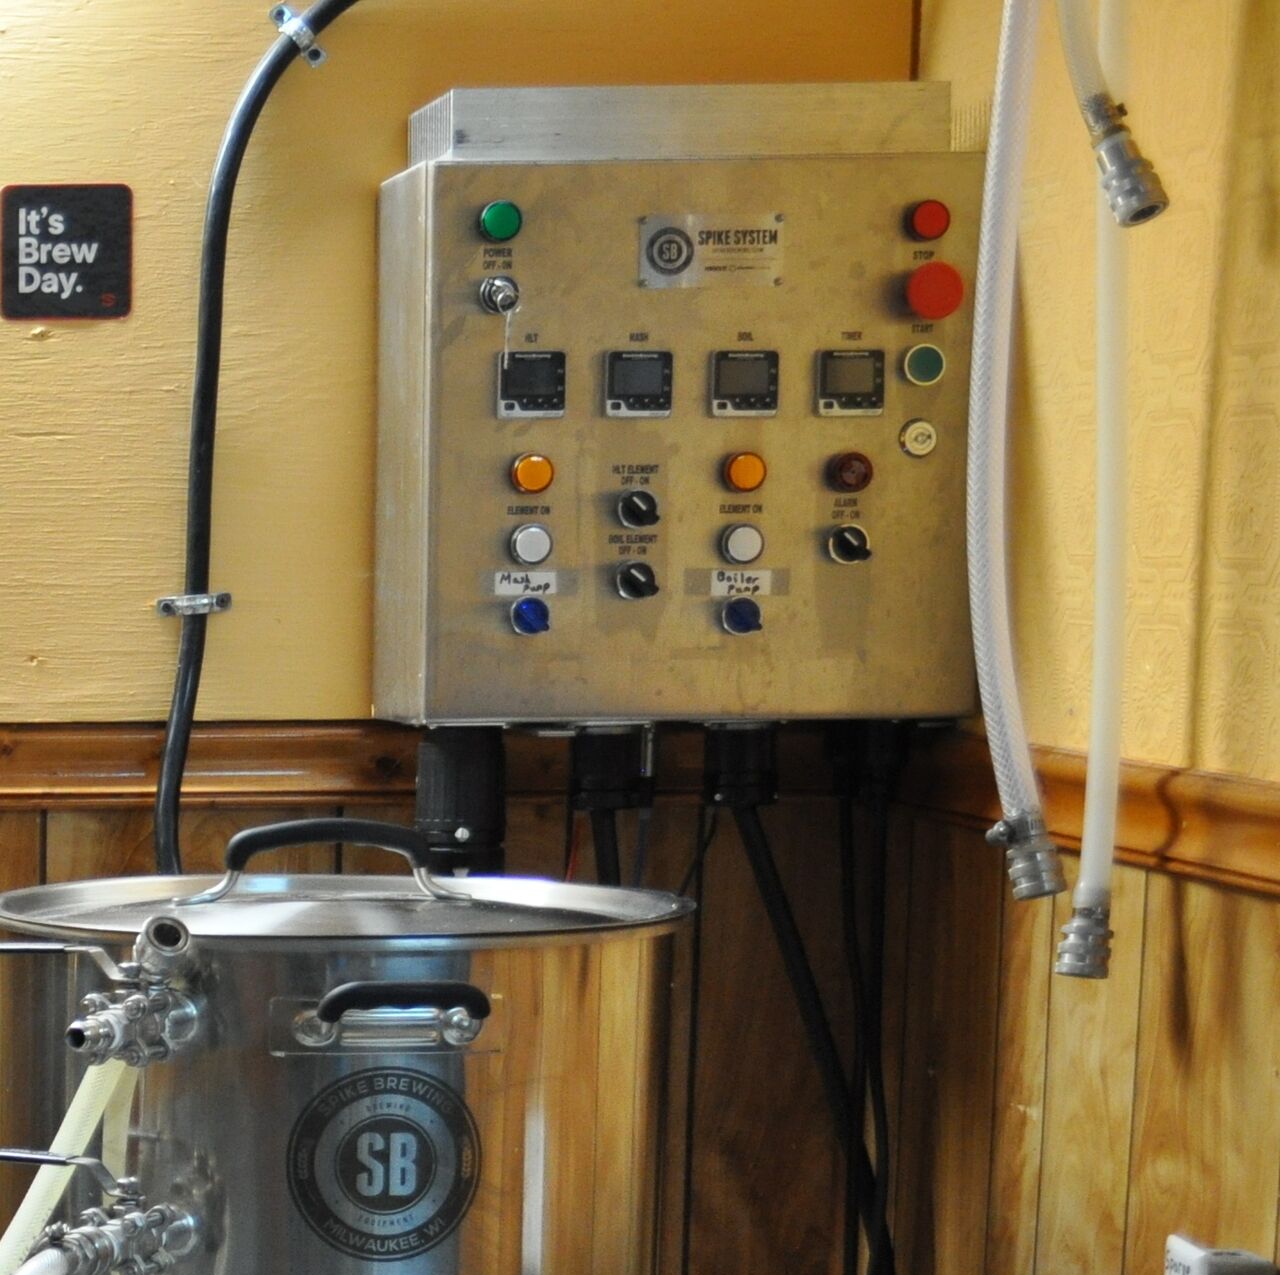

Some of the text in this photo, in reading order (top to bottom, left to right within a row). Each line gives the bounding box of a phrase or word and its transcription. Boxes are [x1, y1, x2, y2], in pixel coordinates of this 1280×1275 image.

[698, 229, 778, 246] SPIKE SYSTEM
[18, 237, 99, 265] Brew
[483, 248, 512, 258] POWER
[662, 243, 678, 260] SB
[913, 251, 935, 260] STOP
[18, 266, 83, 300] Day.
[912, 324, 934, 334] START
[629, 332, 649, 342] MASH
[737, 331, 753, 342] BOIL
[612, 464, 659, 475] HLT ELEMENT
[834, 498, 858, 508] ALARM
[507, 506, 550, 515] ELEMENT ON
[719, 504, 763, 514] ELEMENT ON
[608, 534, 658, 545] BOIL ELEMENT
[500, 572, 531, 584] Mash
[716, 571, 759, 584] Boiler
[727, 585, 760, 595] Pump
[317, 1077, 455, 1117] SPIKE BREWING
[356, 1132, 417, 1196] SB
[323, 1218, 444, 1251] MILWAUKEE, WI
